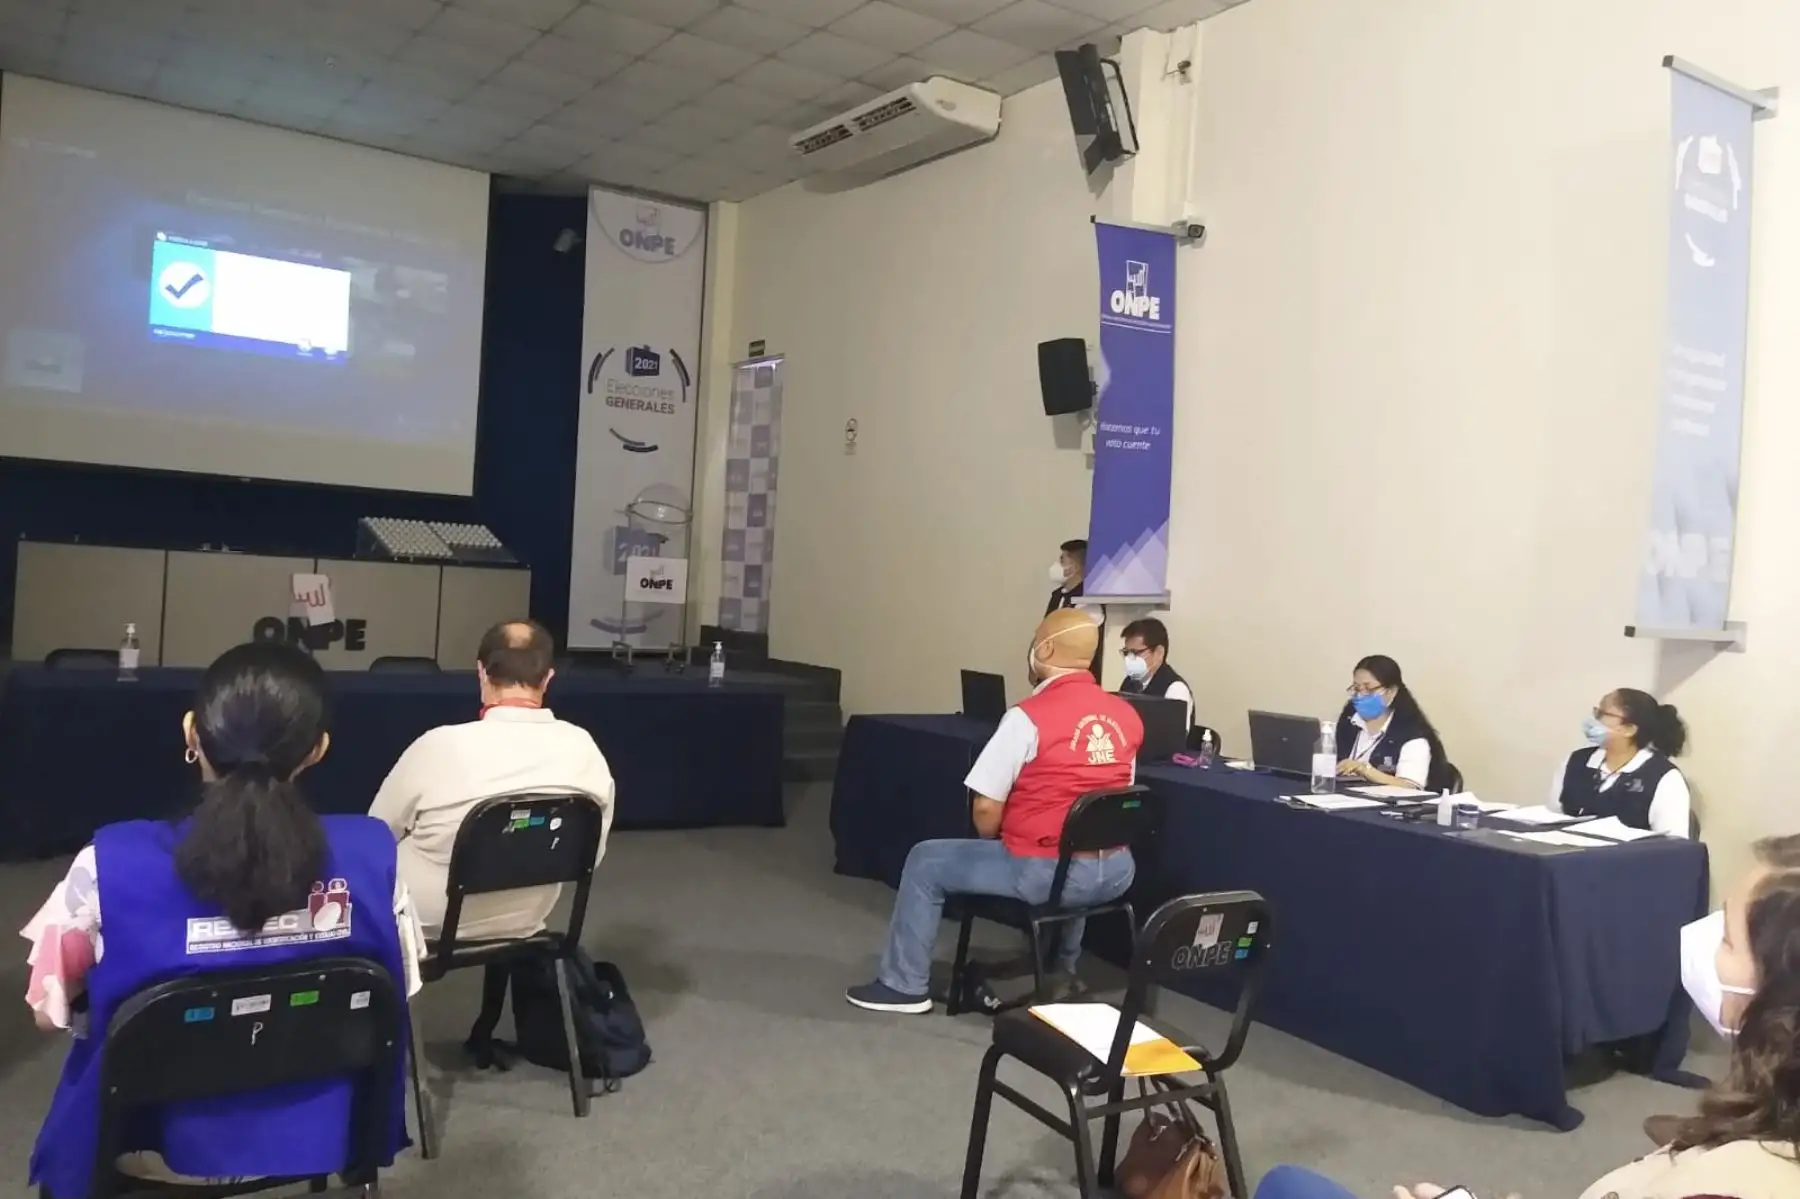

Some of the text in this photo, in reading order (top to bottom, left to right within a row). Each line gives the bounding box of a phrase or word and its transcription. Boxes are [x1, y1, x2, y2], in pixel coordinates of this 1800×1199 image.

[619, 228, 675, 255] ONPE
[1111, 289, 1160, 320] ONPE
[606, 396, 675, 415] GENERALES
[640, 577, 673, 590] ONPE
[1087, 750, 1118, 764] JNE
[191, 913, 300, 939] REEC
